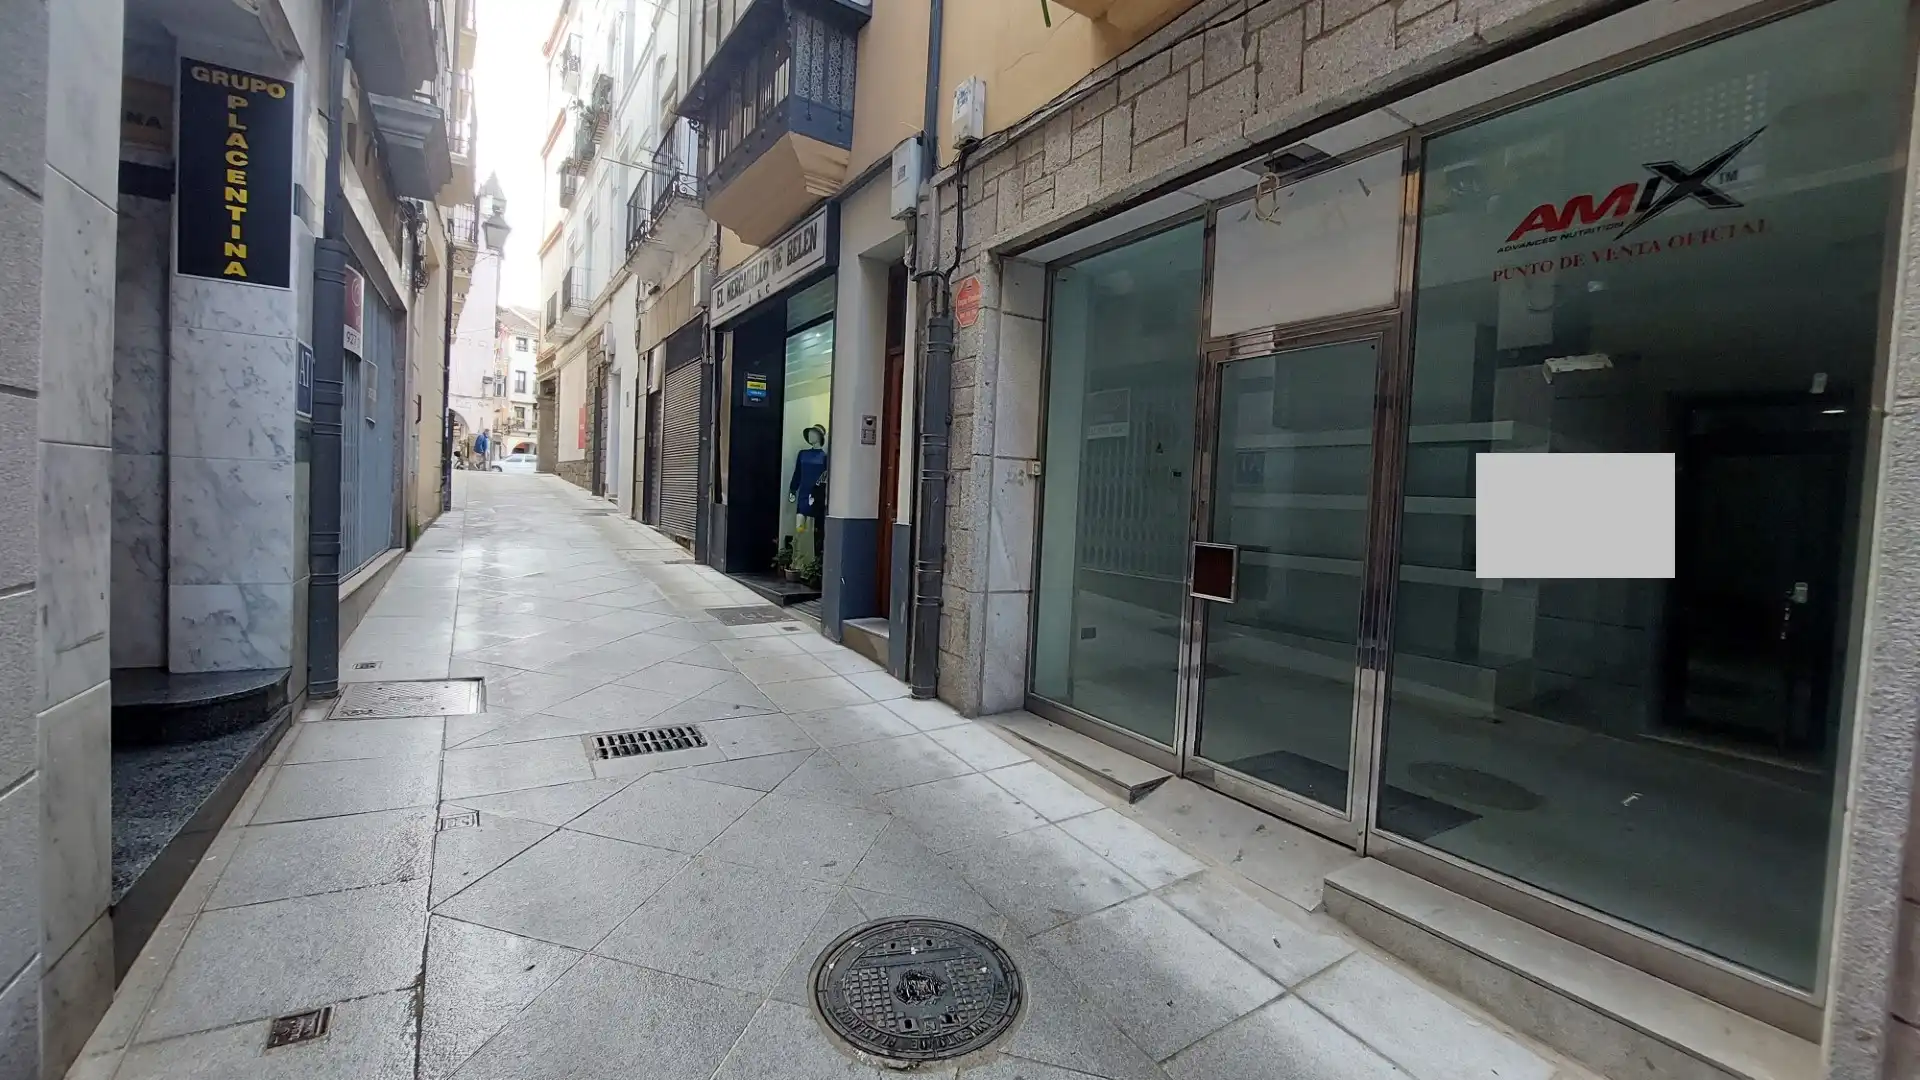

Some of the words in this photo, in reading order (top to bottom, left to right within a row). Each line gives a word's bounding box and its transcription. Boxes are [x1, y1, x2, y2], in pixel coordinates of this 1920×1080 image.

[191, 66, 286, 99] GRUPO
[223, 94, 249, 277] PLACENTINA
[1505, 124, 1769, 242] AMIX
[1492, 259, 1555, 283] PUNTO
[1560, 251, 1586, 270] DE
[1593, 239, 1662, 265] VENTA
[1667, 217, 1771, 250] OFICIAL
[1496, 234, 1558, 254] ADVANCED
[1559, 220, 1625, 241] NUTRITION
[716, 287, 725, 309] EL
